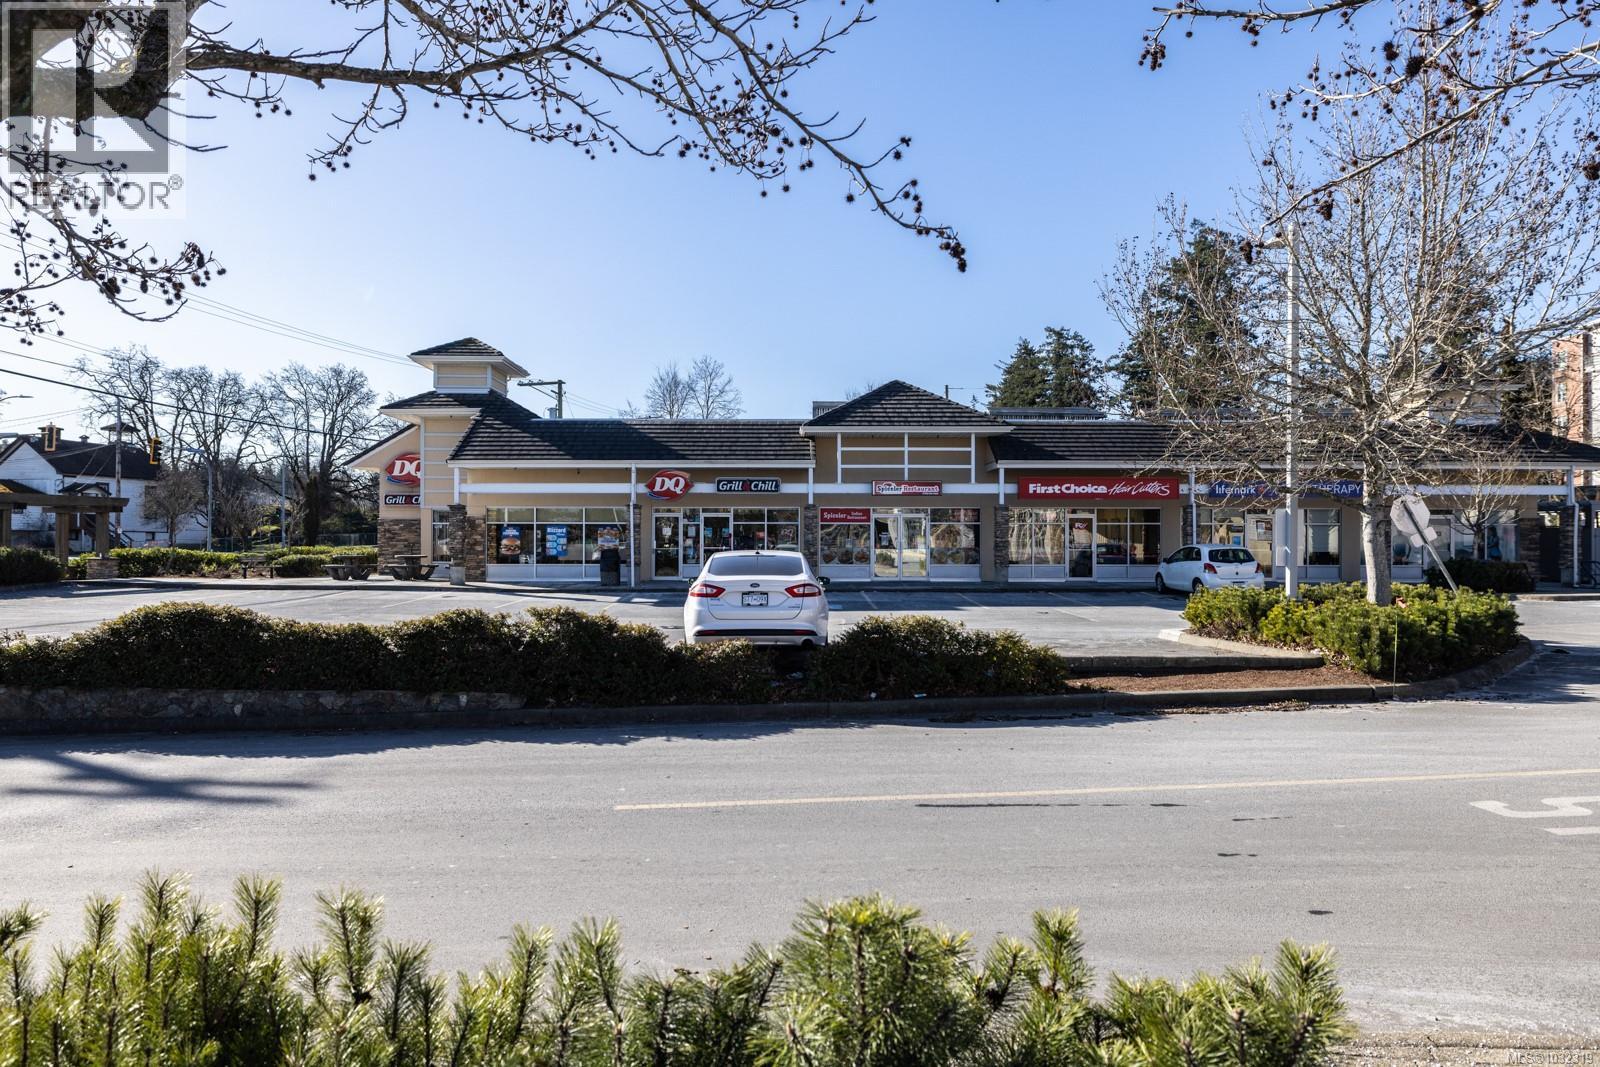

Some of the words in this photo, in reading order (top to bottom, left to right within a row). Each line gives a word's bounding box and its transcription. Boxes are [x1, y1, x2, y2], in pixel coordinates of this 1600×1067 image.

[653, 476, 686, 494] DQ
[719, 480, 743, 491] Grill
[751, 480, 777, 491] Chill
[1029, 483, 1061, 494] First
[1061, 483, 1108, 494] Choice
[386, 496, 406, 504] Grill
